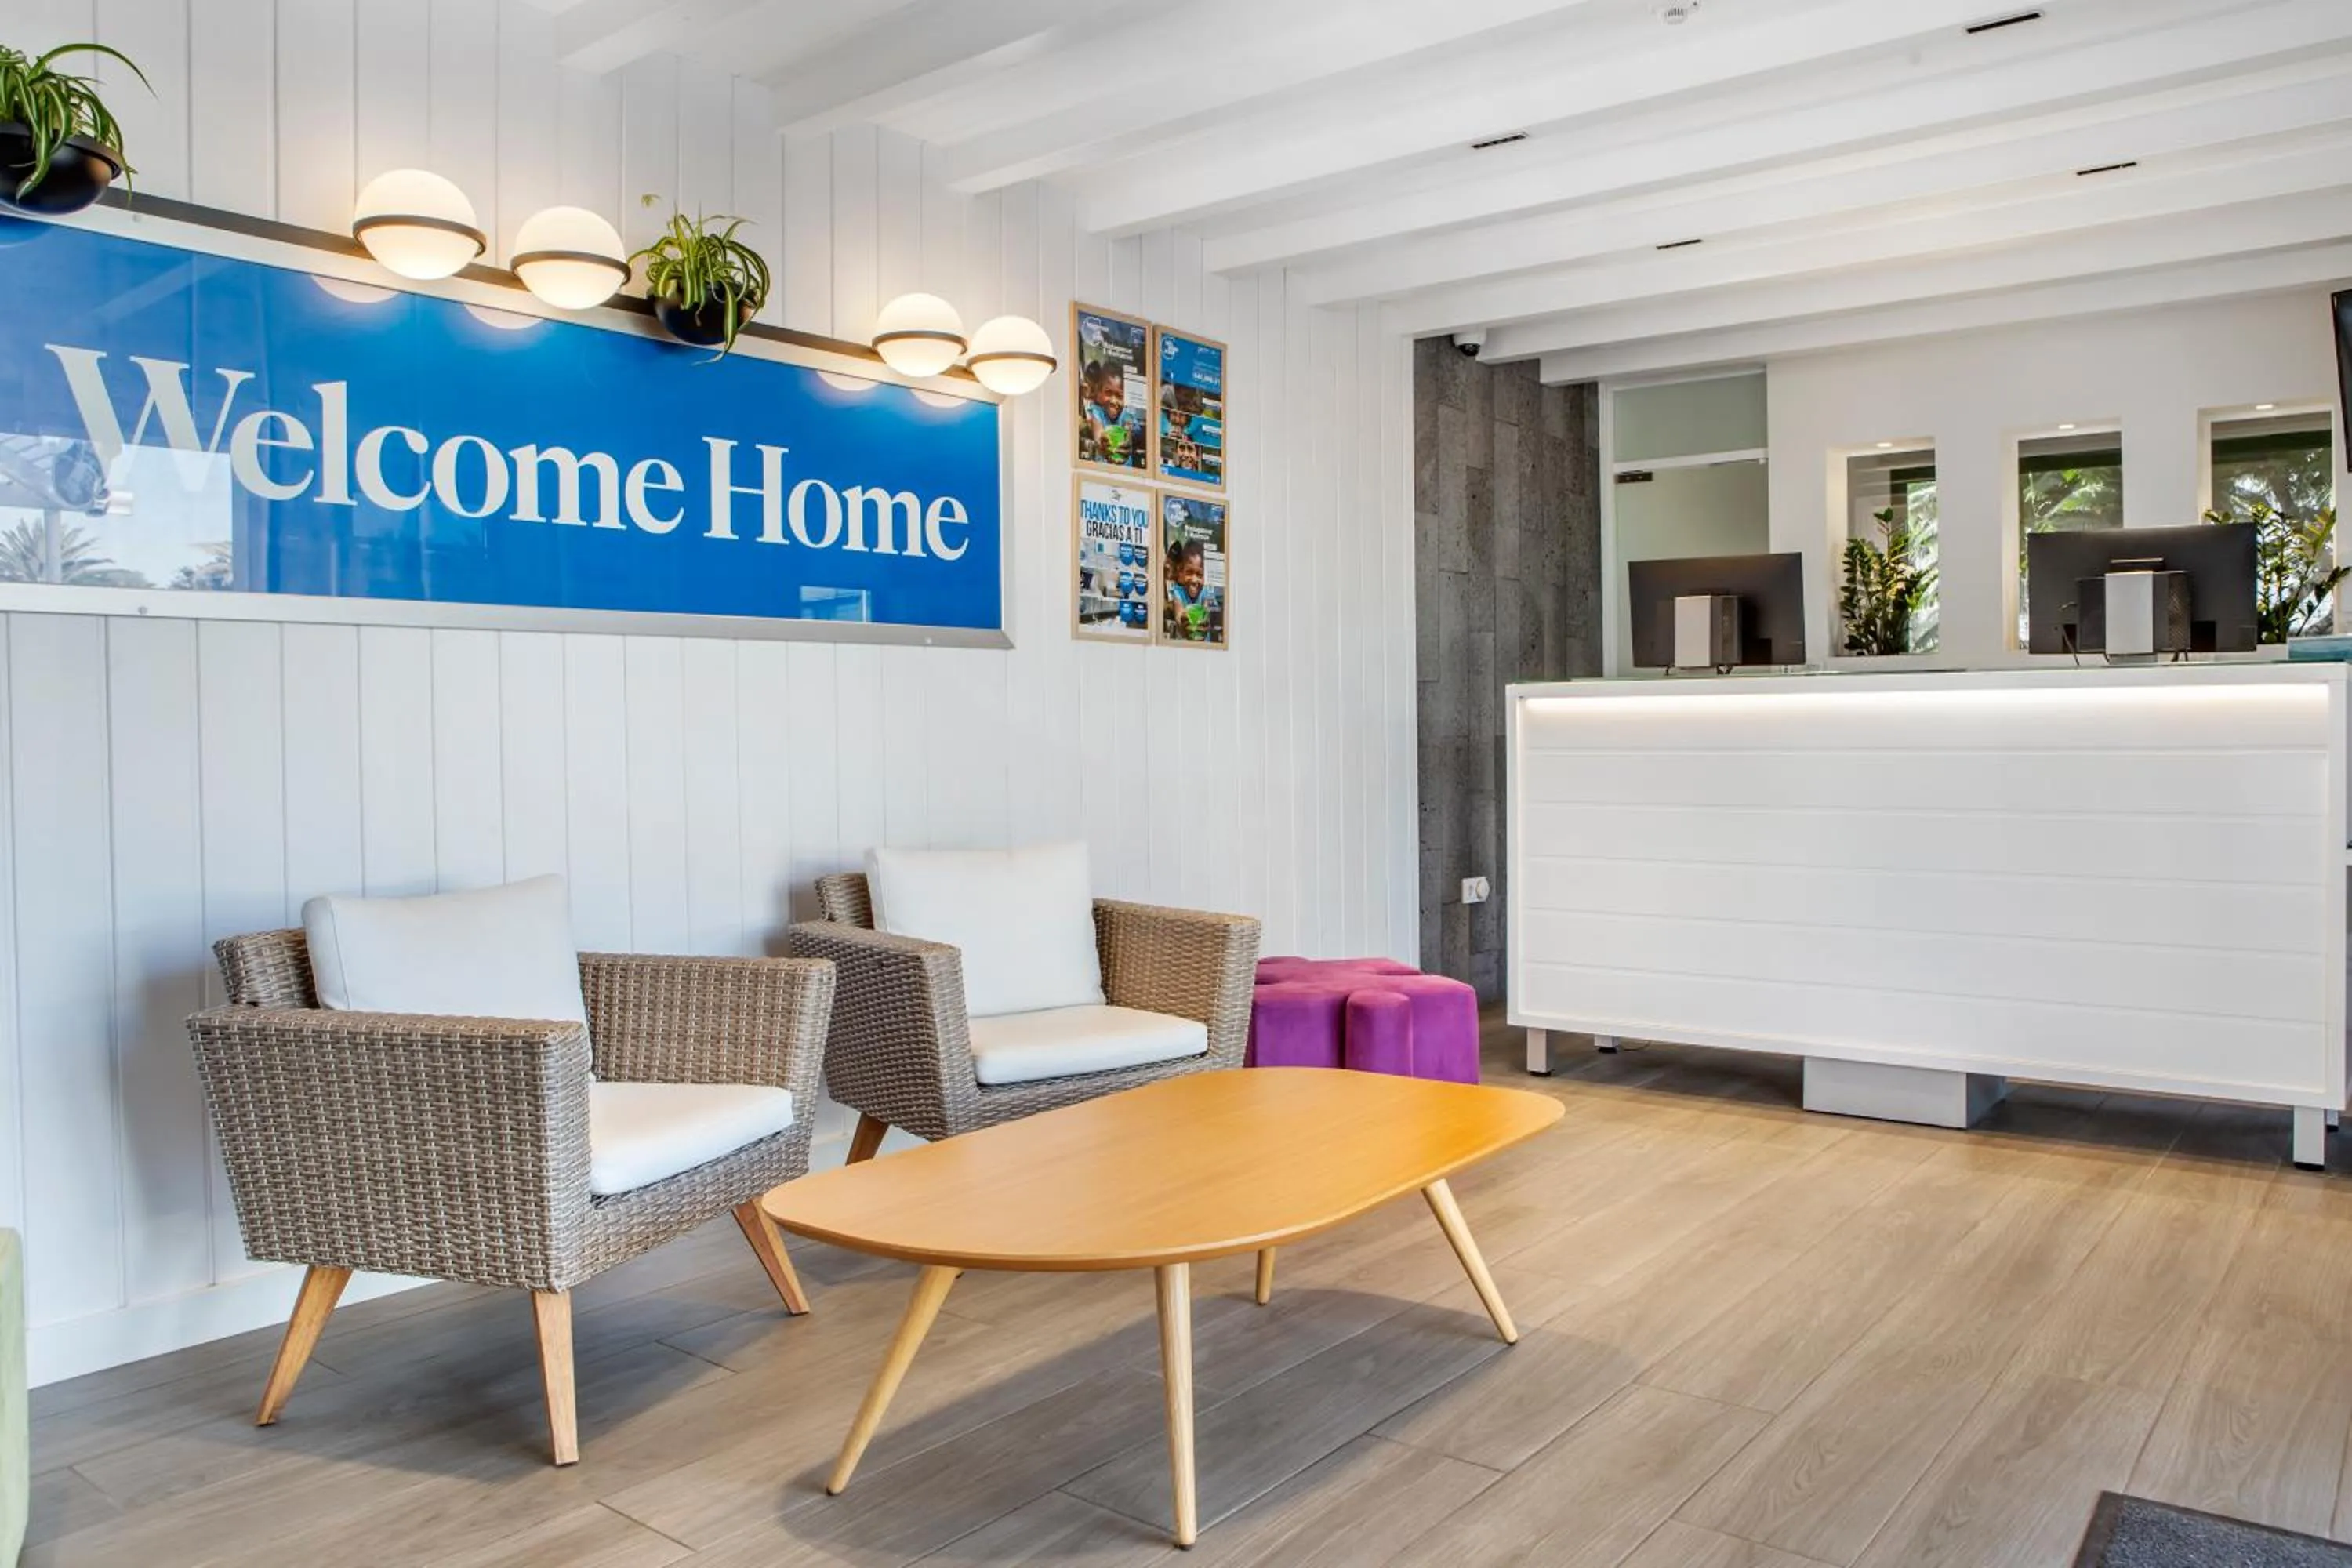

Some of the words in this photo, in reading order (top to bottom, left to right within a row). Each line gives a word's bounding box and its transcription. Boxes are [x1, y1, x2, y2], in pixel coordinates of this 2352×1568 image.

[45, 343, 684, 535] Welcome
[702, 436, 969, 561] Home
[1080, 499, 1117, 523] THANKS
[1118, 506, 1130, 526] TO
[1131, 507, 1149, 528] YOU
[1086, 520, 1125, 541] GRACIAS
[1126, 526, 1133, 543] A
[1134, 527, 1142, 544] TI
